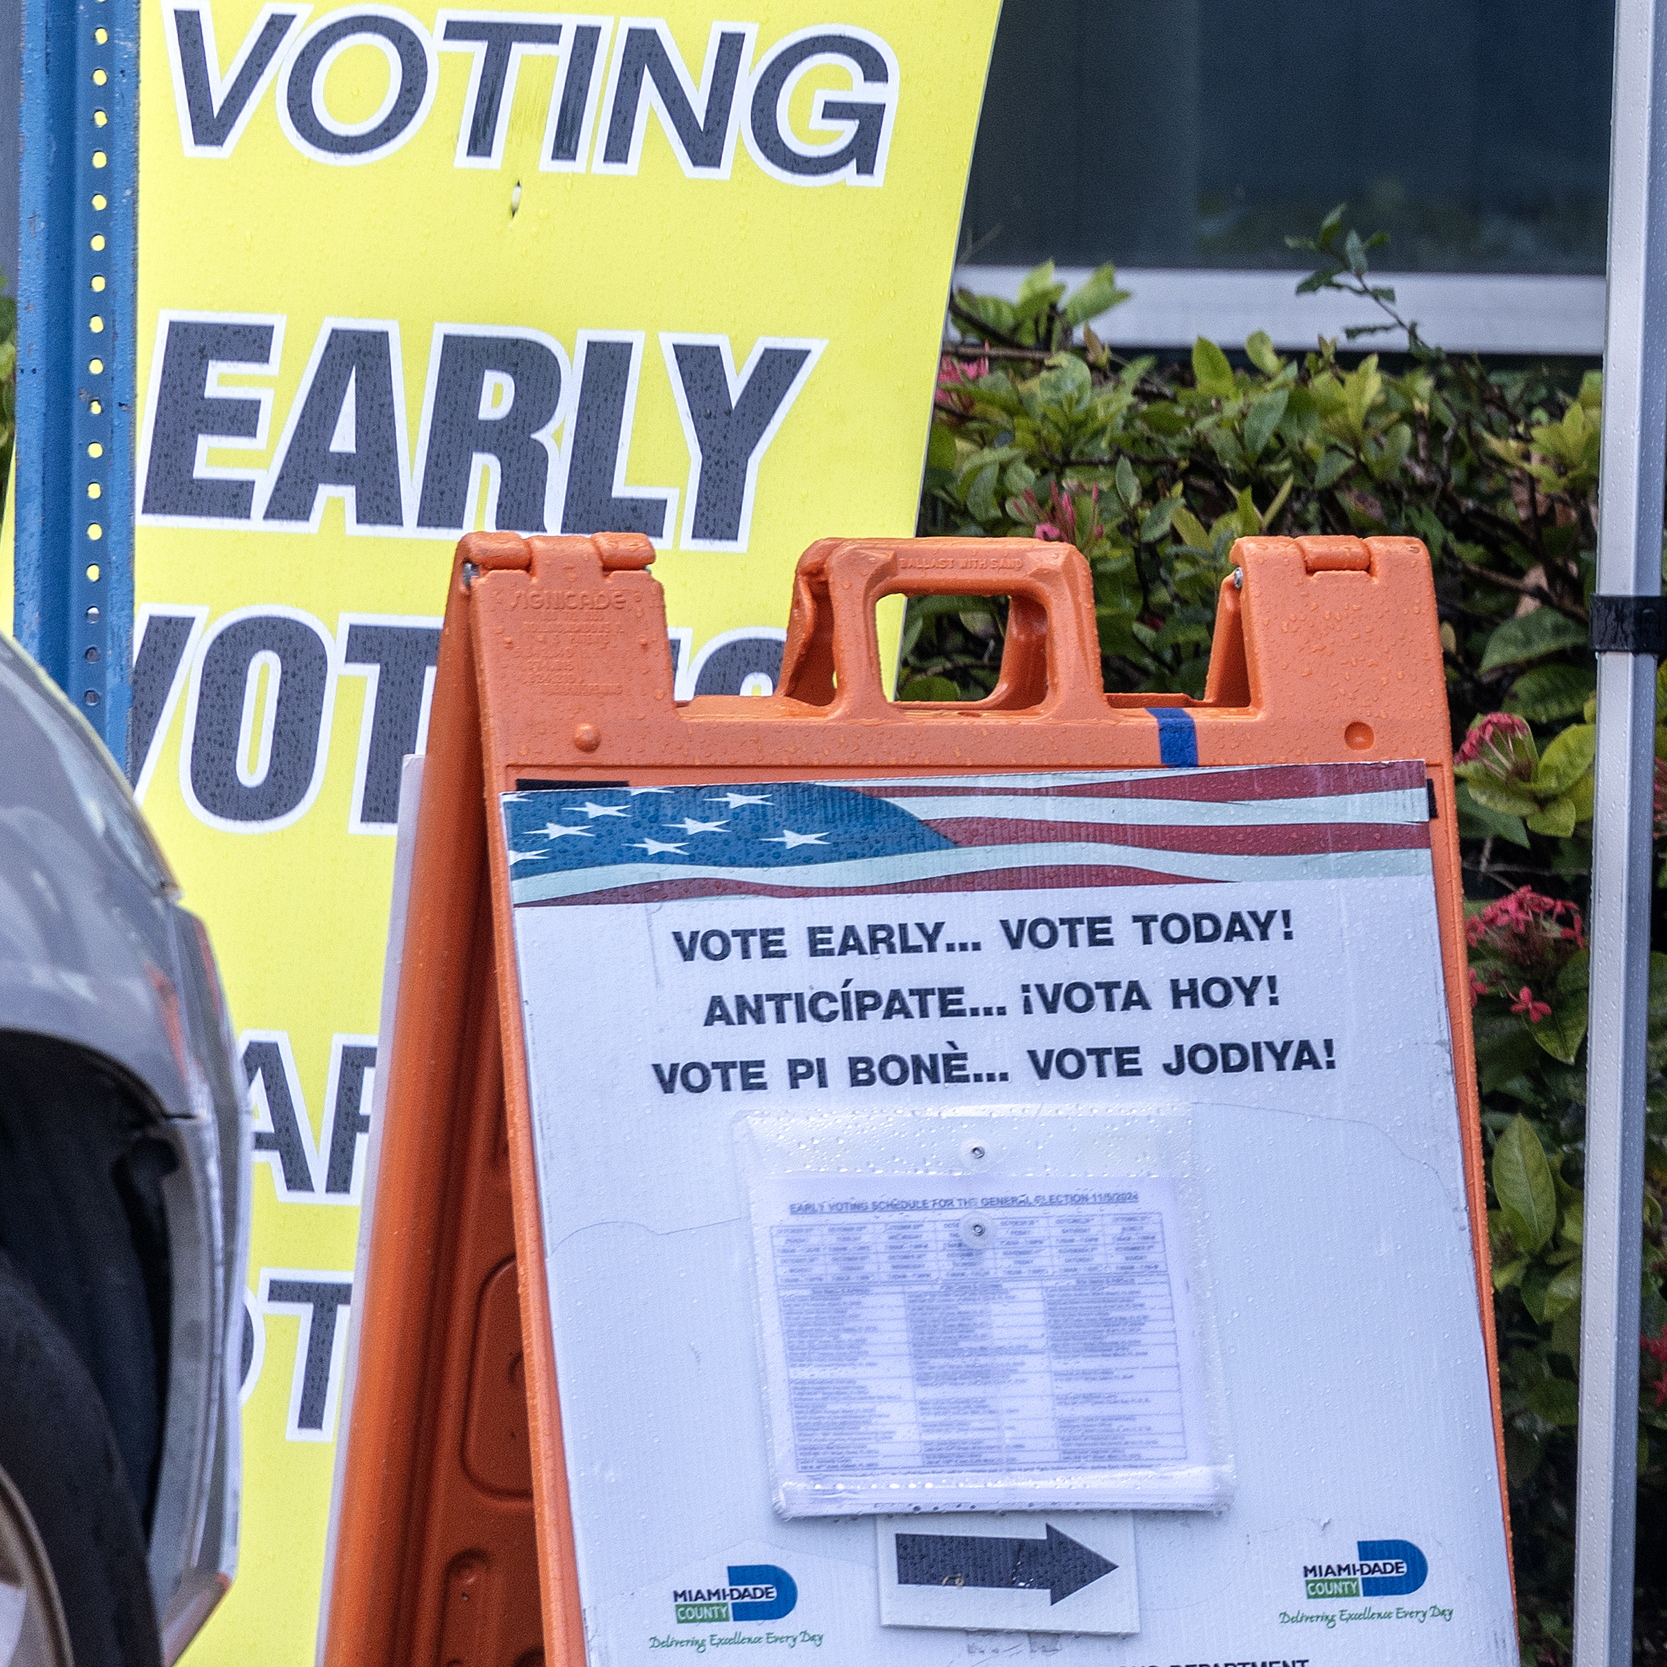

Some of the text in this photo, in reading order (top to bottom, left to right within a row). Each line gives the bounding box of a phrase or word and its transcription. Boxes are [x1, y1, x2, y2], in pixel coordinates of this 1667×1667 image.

[164, 2, 896, 182] VOTING
[138, 313, 822, 546] EARLY
[898, 558, 1024, 572] BALLAST WITH SAND
[510, 590, 627, 610] SIGNICADE
[672, 909, 1294, 962] VOTE EARLY... VOTE TODAY!
[702, 975, 1280, 1027] ANTICÍPATE... ¡VOTA HOY!
[651, 1038, 1337, 1094] VOTE PI BONÈ... VOTE JODIYA!
[789, 1202, 824, 1214] EARLY
[828, 1201, 868, 1213] VOTING
[871, 1199, 929, 1212] SCHEDULE
[1303, 1561, 1405, 1578] MIAMI-DADE
[673, 1586, 775, 1603] MIAMI-DADE
[1307, 1580, 1358, 1596] COUNTY
[677, 1605, 728, 1620] COUNTY
[1279, 1604, 1454, 1629] Delivering Excellence Every Day
[649, 1629, 824, 1653] Delivering Excellence Every Day
